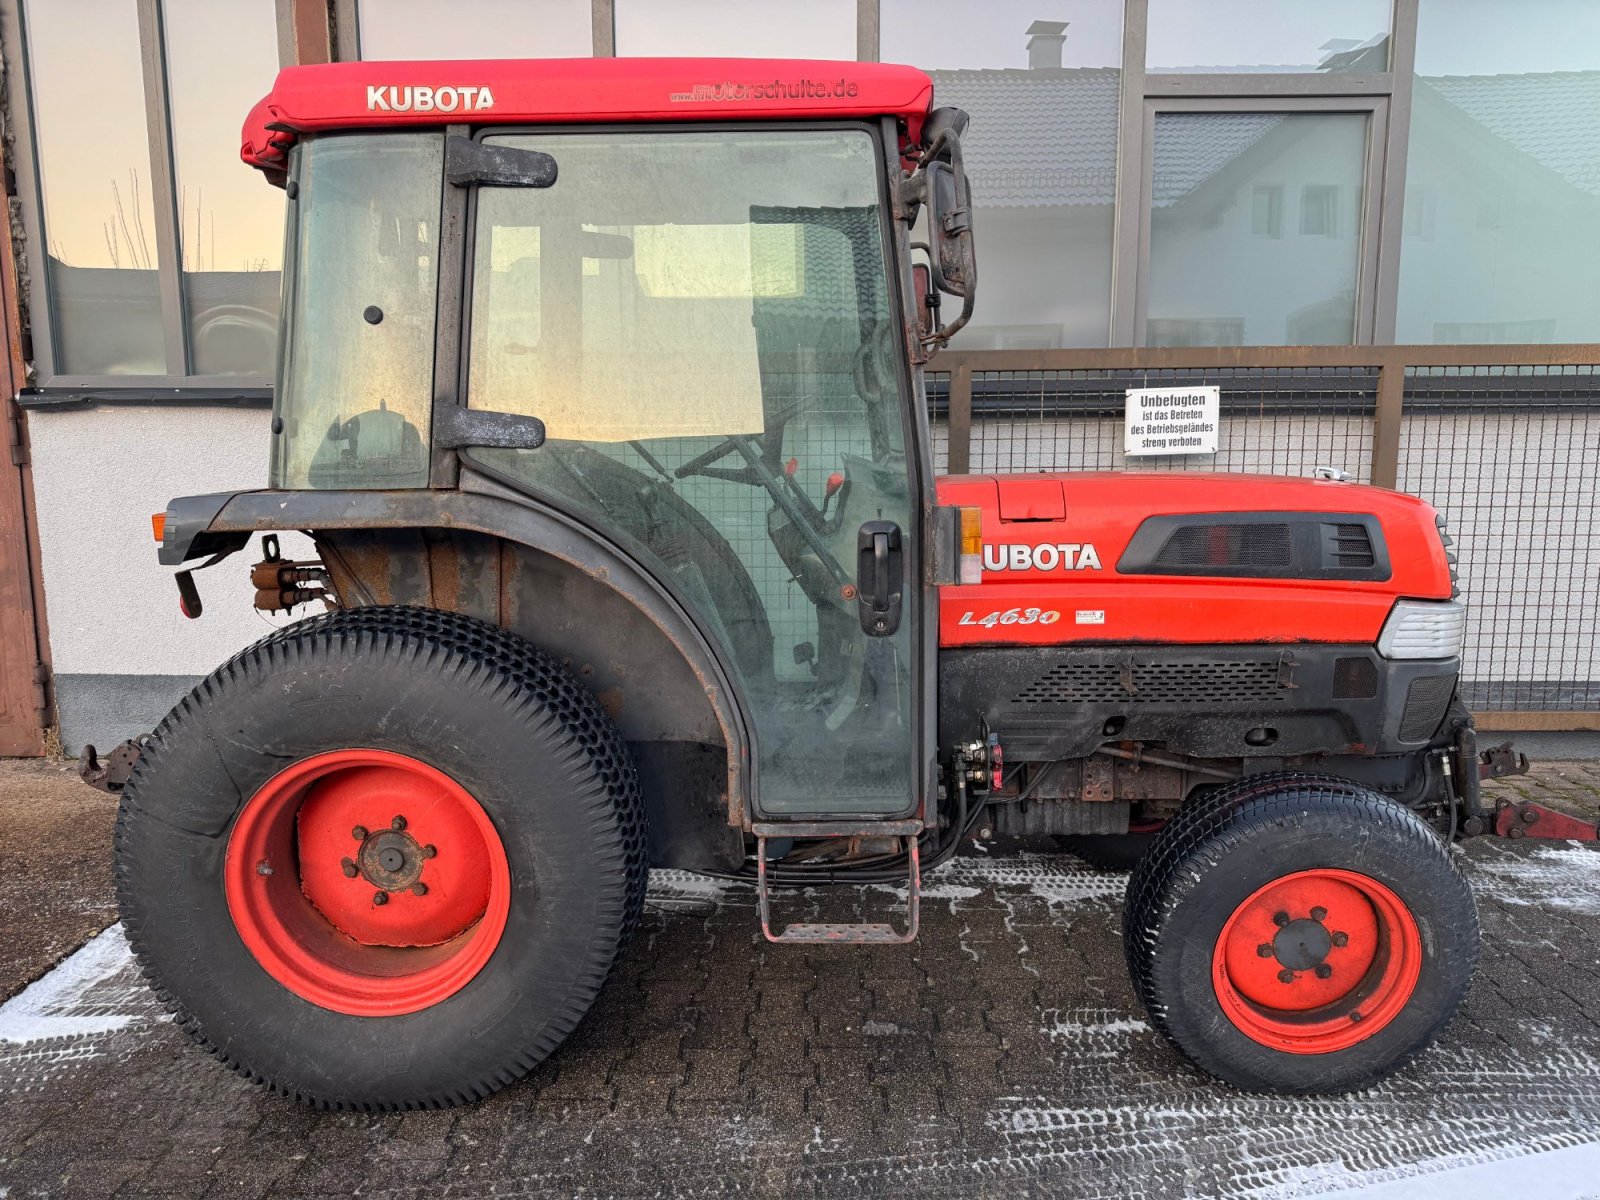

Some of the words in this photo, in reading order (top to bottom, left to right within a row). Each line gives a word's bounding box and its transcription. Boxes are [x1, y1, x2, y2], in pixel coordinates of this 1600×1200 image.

[366, 84, 495, 112] KUBOTA
[1140, 394, 1206, 407] Unbefugten
[1142, 411, 1153, 421] ist
[1154, 410, 1169, 420] das
[1170, 409, 1203, 420] Betreten
[1130, 425, 1145, 435] des
[1146, 422, 1214, 434] Betriebsgeländes
[1141, 438, 1167, 448] streng
[1168, 436, 1202, 447] verboten
[981, 542, 1103, 572] UBOTA
[958, 607, 1061, 628] L4630
